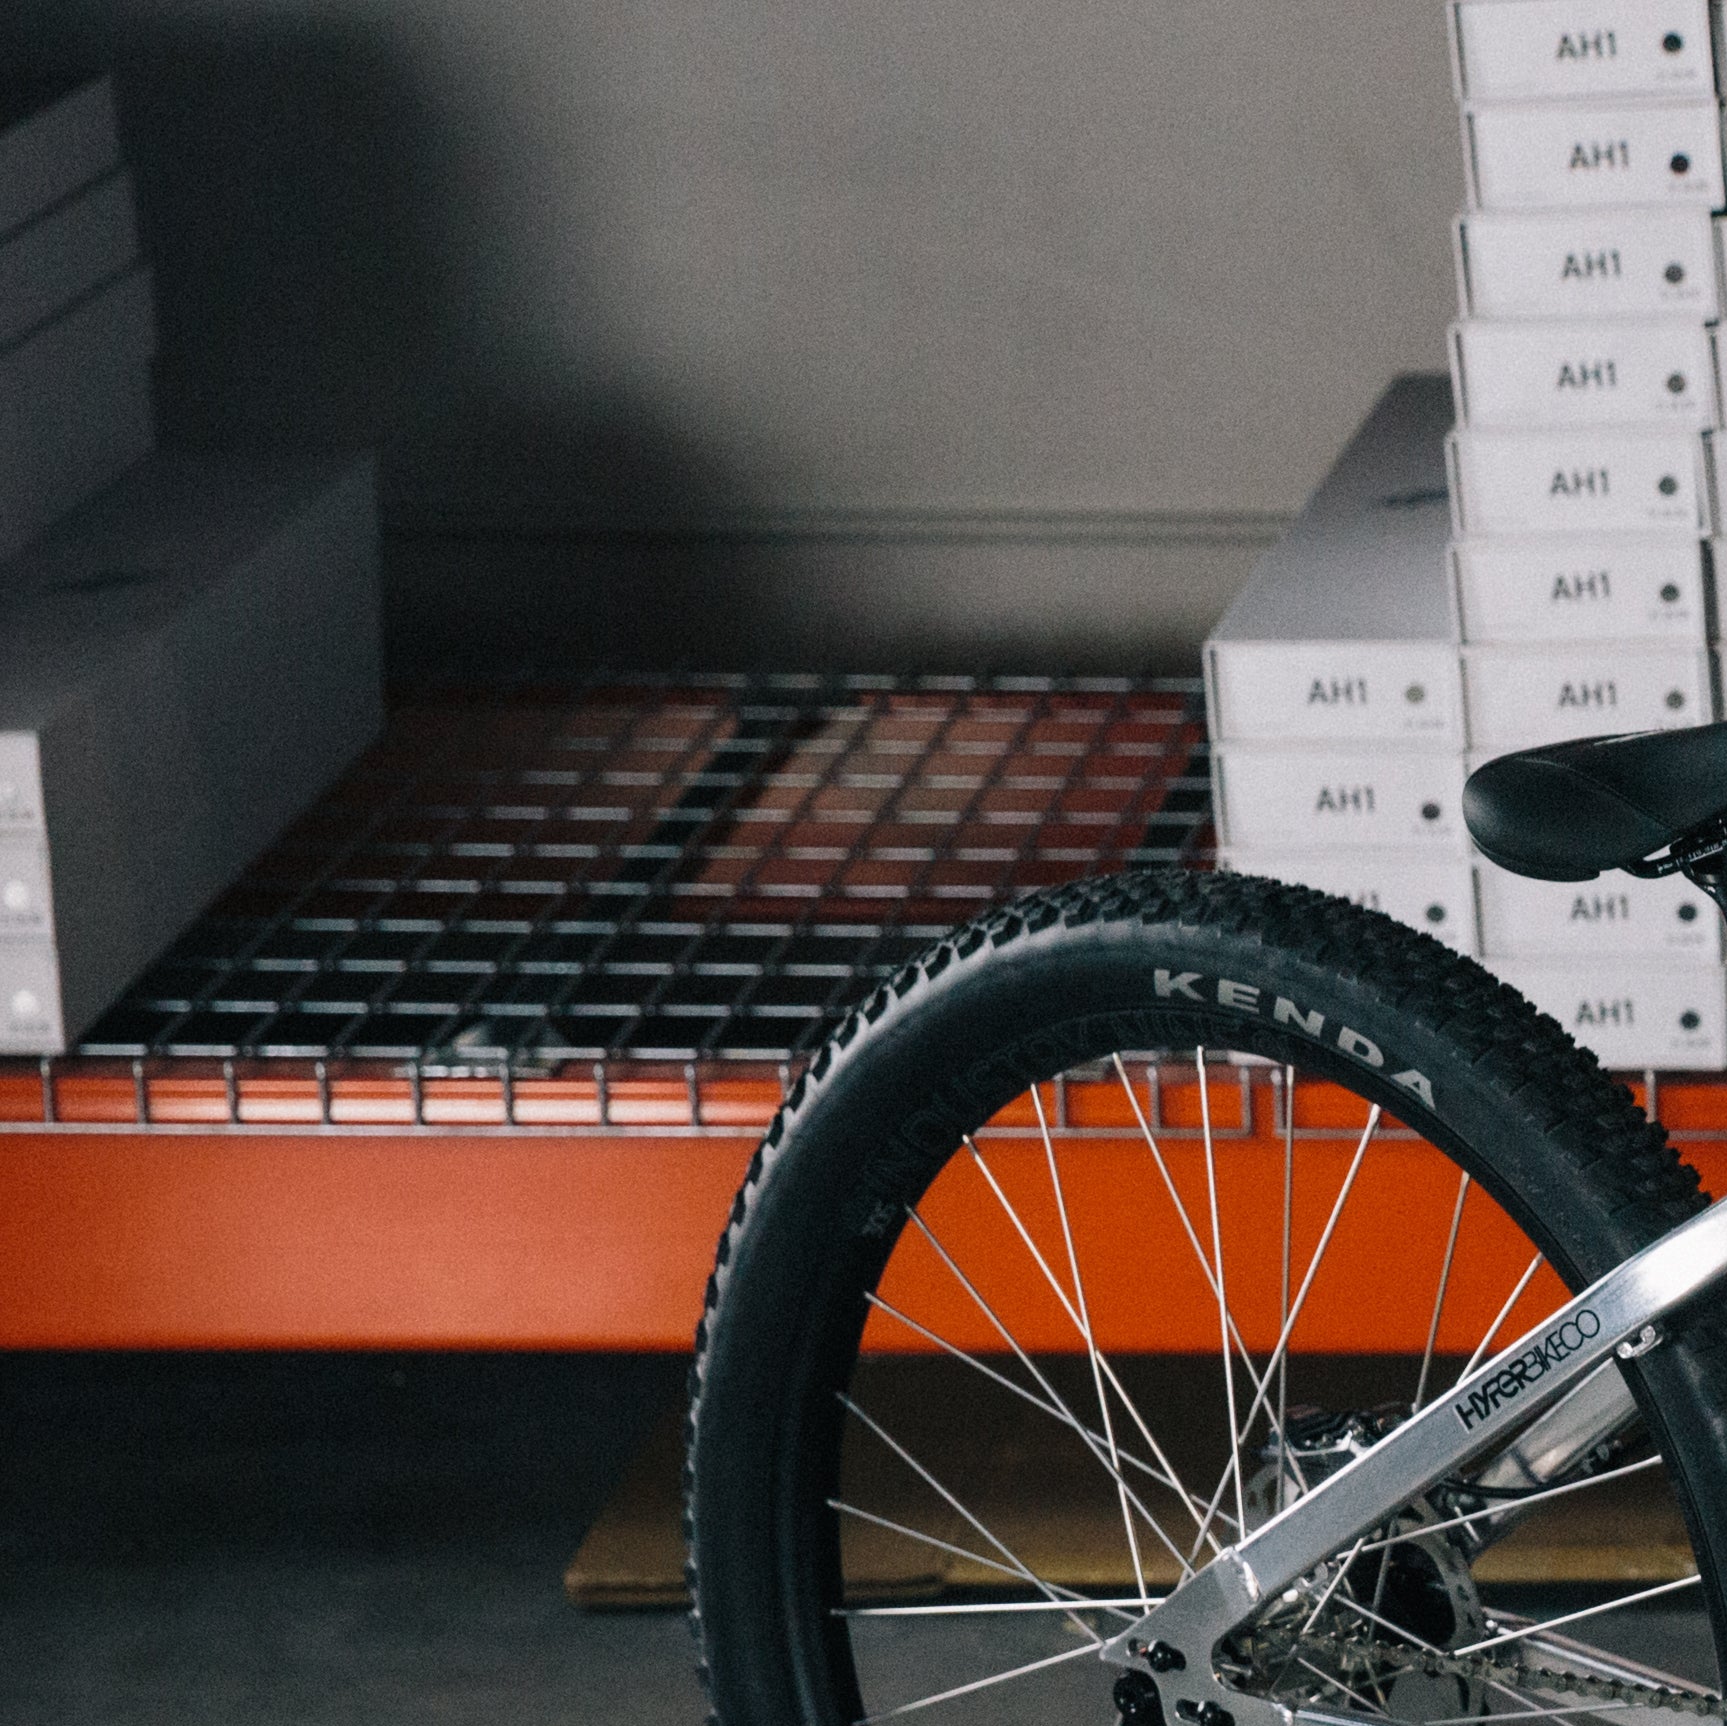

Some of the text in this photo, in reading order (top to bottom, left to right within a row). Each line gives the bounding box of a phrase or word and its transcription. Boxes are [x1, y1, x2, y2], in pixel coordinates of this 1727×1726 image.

[1556, 30, 1617, 61] AH1
[1568, 140, 1630, 170] AH1
[1561, 250, 1622, 280] AH1
[1556, 360, 1617, 389] AH1
[1549, 468, 1610, 496] AH1
[1551, 571, 1611, 602] AH1
[1307, 678, 1368, 705] AH1
[1557, 681, 1618, 708] AH1
[1315, 786, 1375, 812] AH1
[1571, 896, 1630, 922] AH1
[1575, 1000, 1635, 1025] AH1
[1153, 968, 1437, 1112] KENDA
